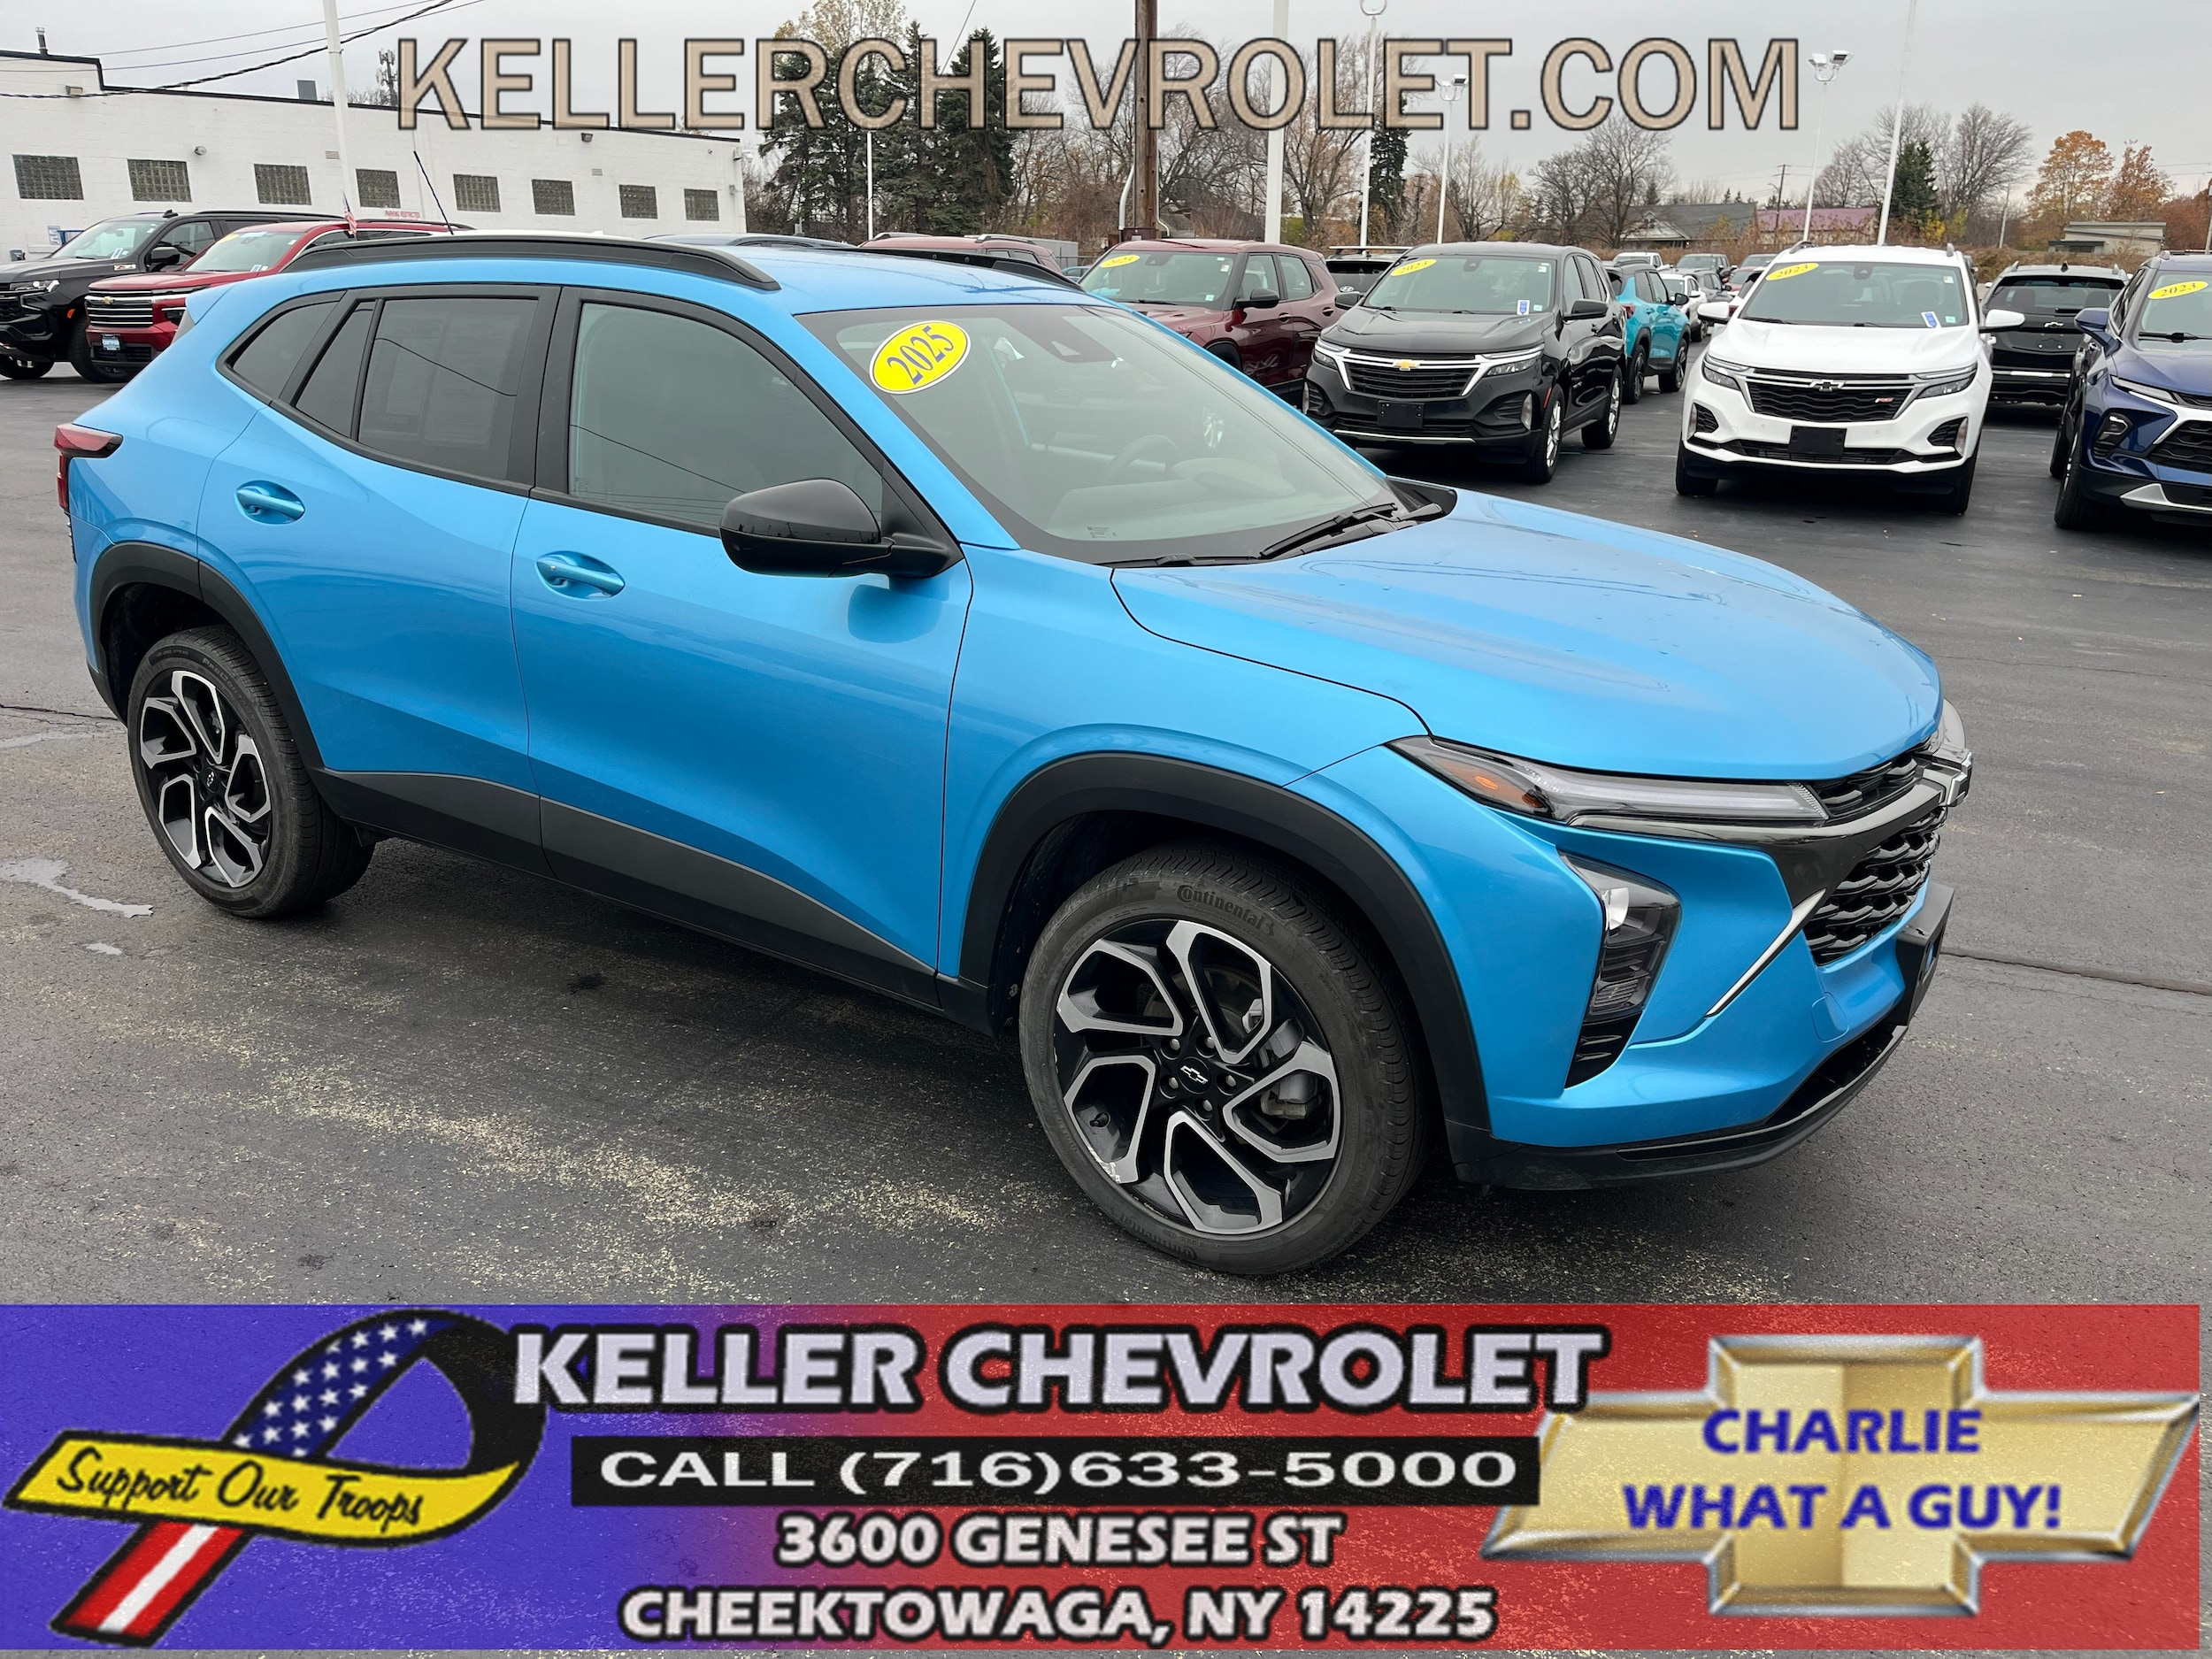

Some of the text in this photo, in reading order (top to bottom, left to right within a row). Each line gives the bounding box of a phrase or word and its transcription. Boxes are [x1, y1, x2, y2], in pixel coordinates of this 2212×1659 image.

[2161, 282, 2196, 297] 2023
[887, 326, 954, 385] 2025
[1177, 884, 1265, 930] Continental
